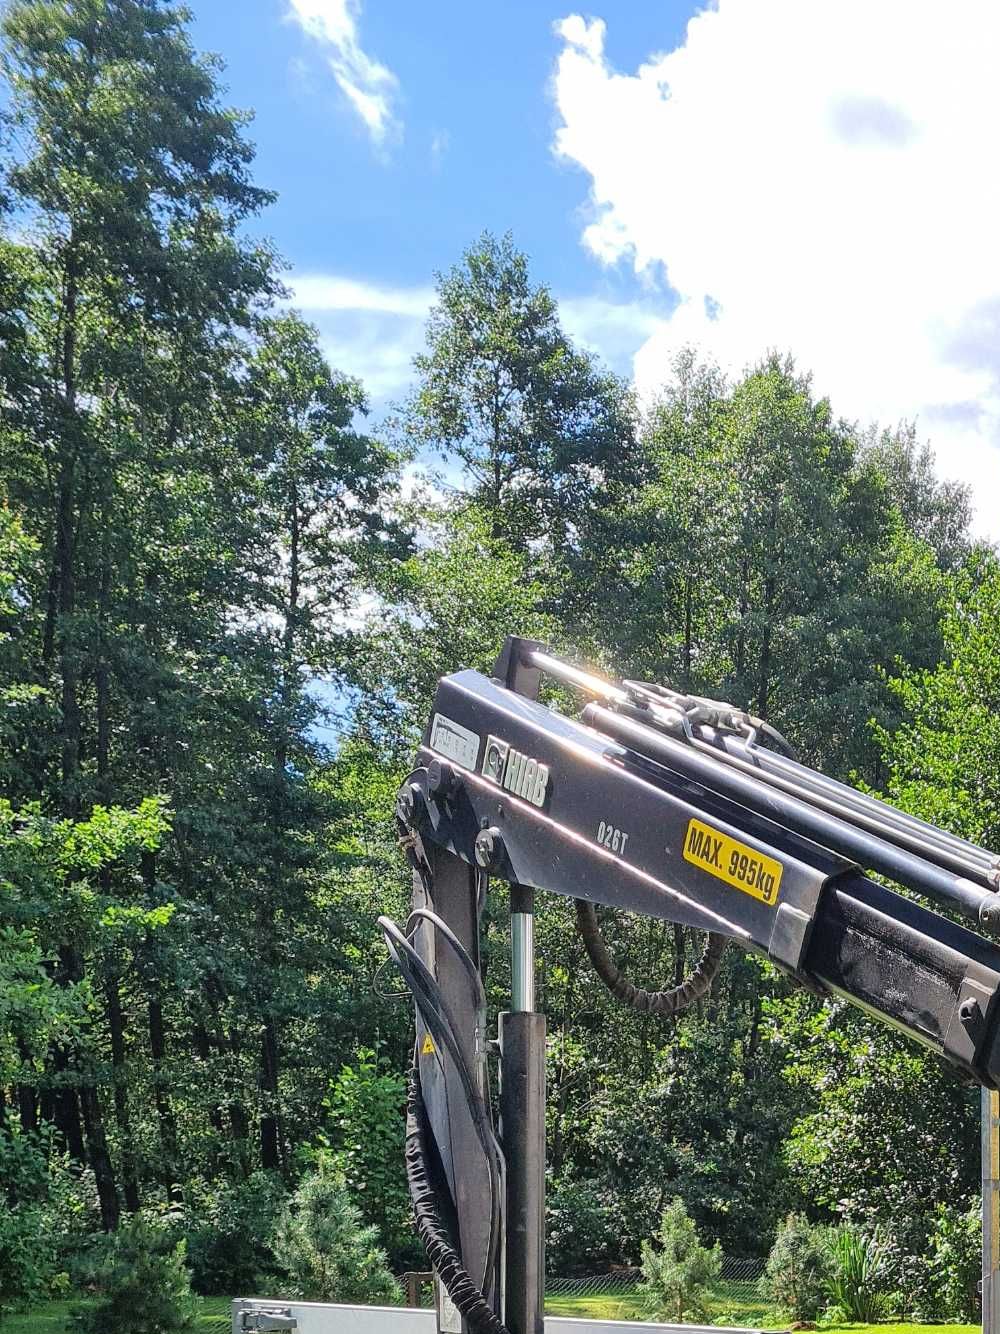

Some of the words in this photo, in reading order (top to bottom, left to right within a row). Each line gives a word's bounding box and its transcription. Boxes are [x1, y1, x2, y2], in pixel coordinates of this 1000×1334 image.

[503, 748, 549, 807] HIAB
[597, 821, 629, 855] 026T
[687, 827, 723, 870] MAX.
[728, 850, 775, 902] 995kg
